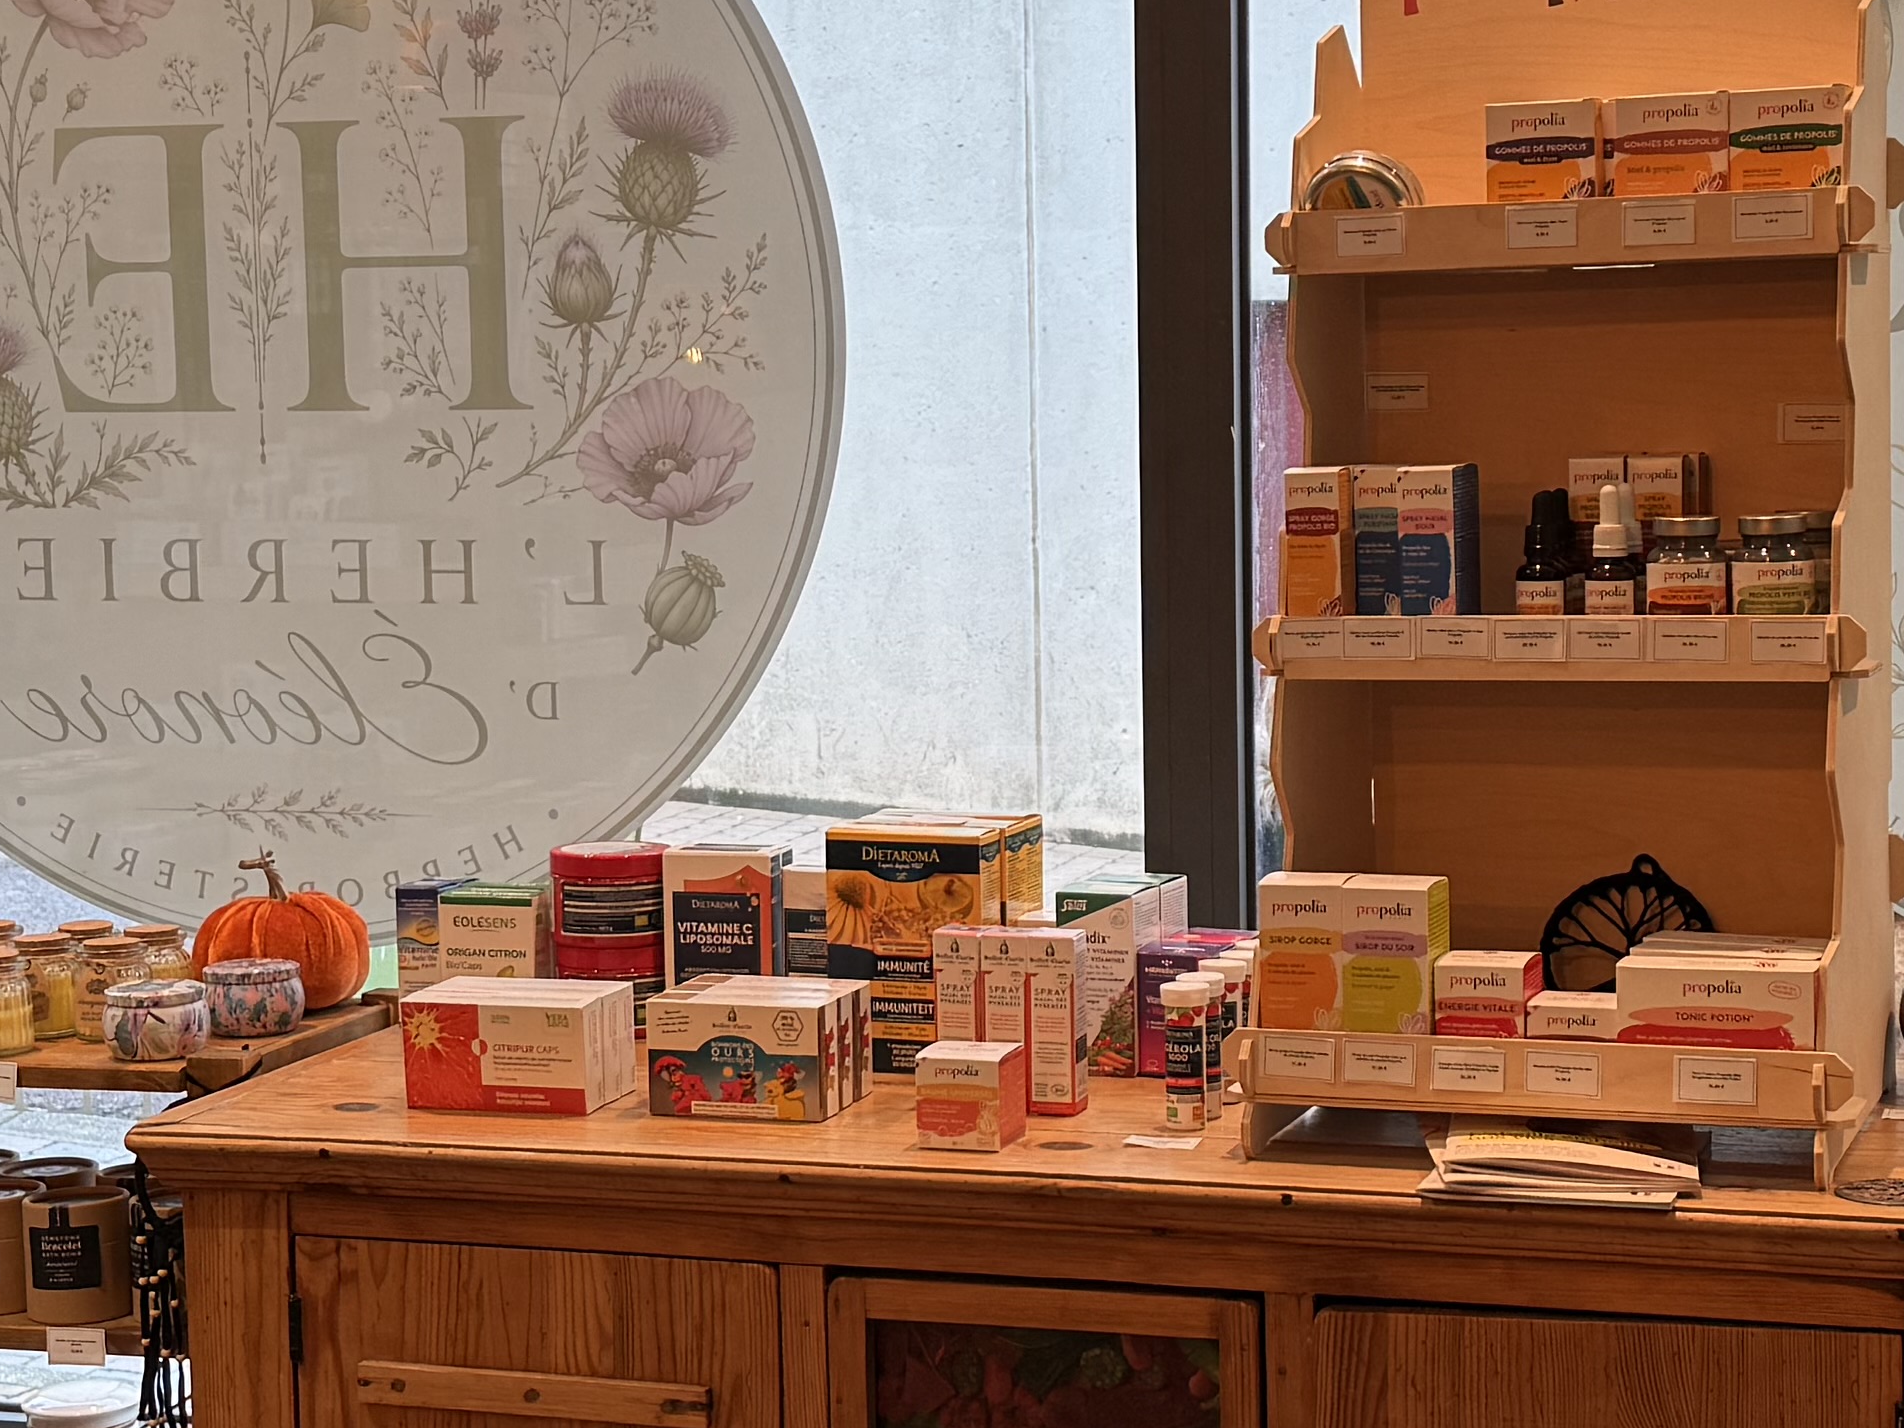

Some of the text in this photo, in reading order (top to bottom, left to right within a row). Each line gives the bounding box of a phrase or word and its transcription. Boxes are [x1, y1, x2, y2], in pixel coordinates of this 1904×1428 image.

[1643, 103, 1699, 123] propolia
[1758, 98, 1814, 120] propolia
[1511, 112, 1566, 133] propolia
[1358, 482, 1396, 498] propoli
[1664, 568, 1710, 583] propolia
[1758, 563, 1804, 581] propolia
[1272, 899, 1327, 917] propolia
[1356, 902, 1412, 920] propolia
[677, 922, 753, 934] VITAMINE C
[1269, 935, 1296, 945] SIROP
[446, 947, 527, 959] ORIGAN CITRON
[877, 960, 930, 973] IMMUNITÉ
[1450, 972, 1506, 990] propolia
[1682, 979, 1742, 998] propolia
[1547, 1014, 1597, 1029] propolia
[1675, 1011, 1707, 1022] TONIC
[934, 1064, 979, 1079] propolia
